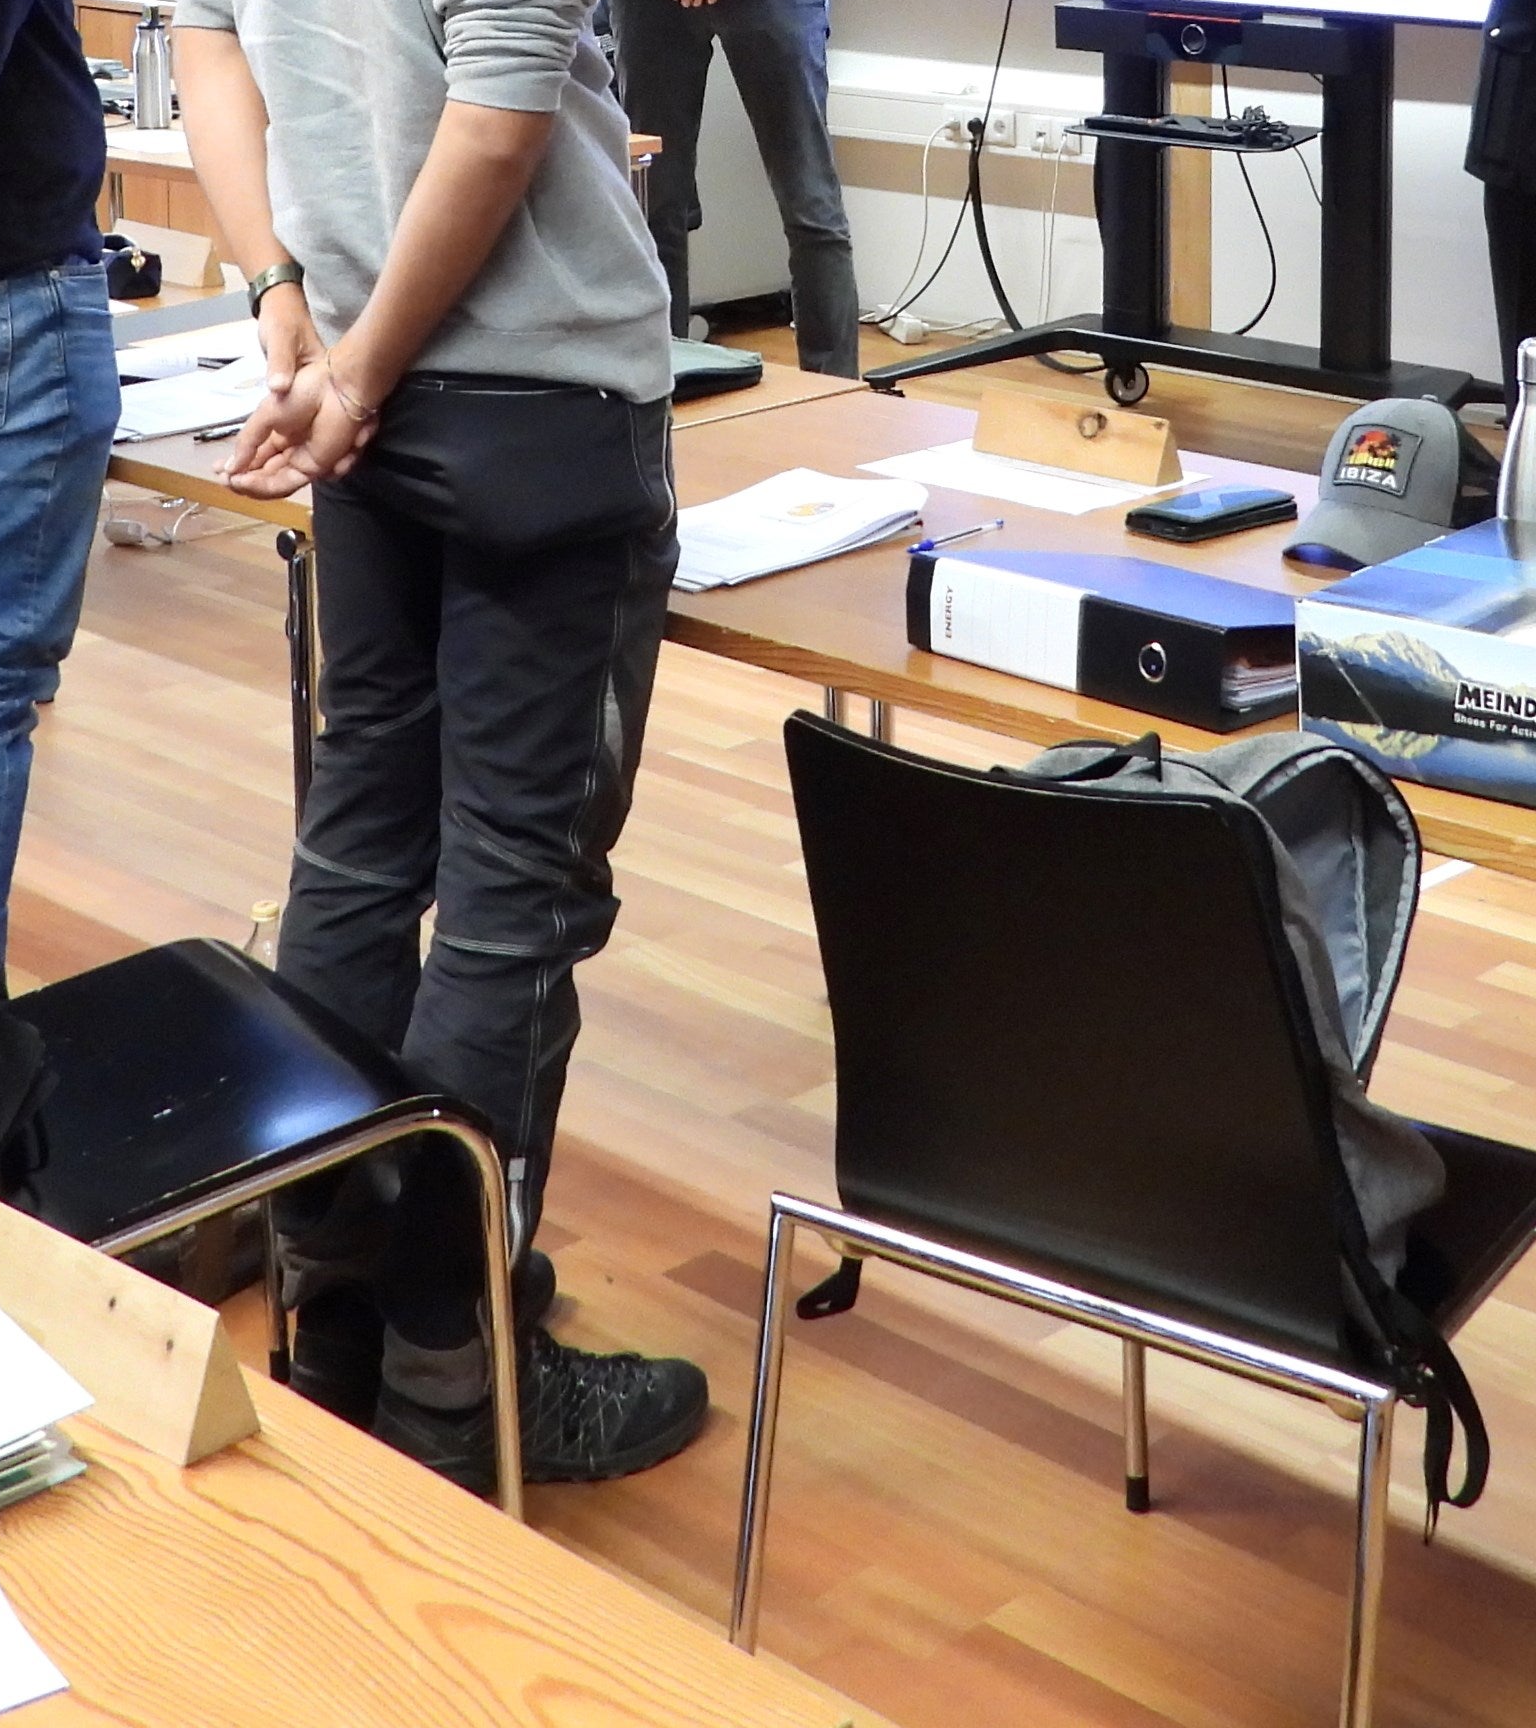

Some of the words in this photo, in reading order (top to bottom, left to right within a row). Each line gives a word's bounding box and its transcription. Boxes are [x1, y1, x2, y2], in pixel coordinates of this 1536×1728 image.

[1339, 466, 1398, 489] IBIZA
[945, 586, 954, 639] ENERGY
[1454, 712, 1486, 729] Shoes
[1489, 719, 1507, 731] For
